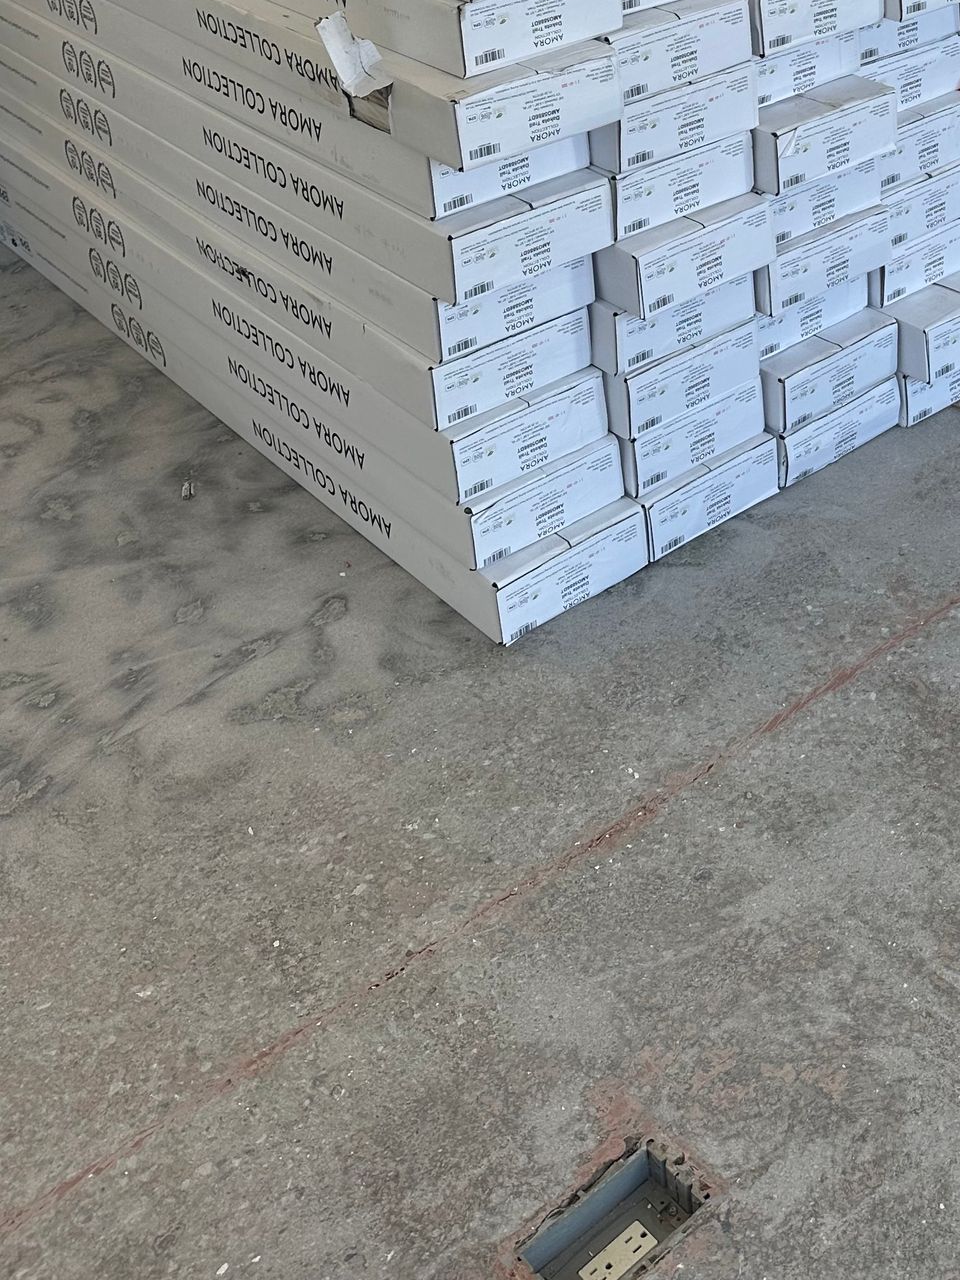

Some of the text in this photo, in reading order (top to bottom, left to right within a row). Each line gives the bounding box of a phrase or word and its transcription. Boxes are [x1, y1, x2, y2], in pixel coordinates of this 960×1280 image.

[814, 24, 837, 36] AMORA
[534, 33, 564, 47] AMORA
[196, 8, 339, 94] AMORA COLLECTION
[672, 68, 699, 81] AMORA
[183, 58, 321, 142] AMORA COLLECTION
[530, 128, 560, 142] AMORA
[679, 136, 705, 149] AMORA
[827, 158, 850, 171] AMORA
[203, 126, 343, 220] AMORA COLLECTION
[501, 176, 531, 190] AMORA
[674, 200, 700, 214] AMORA
[196, 179, 332, 275] AMORA COLLECTION
[813, 215, 835, 228] AMORA
[522, 260, 552, 275] AMORA
[698, 273, 724, 287] AMORA
[827, 275, 848, 289] AMORA
[280, 291, 331, 339] AMORA
[505, 316, 535, 331] AMORA
[677, 328, 703, 344] AMORA
[212, 299, 349, 407] AMORA COLLECTION
[505, 382, 534, 397] AMORA
[686, 393, 710, 407] AMORA
[833, 392, 855, 405] AMORA
[228, 356, 364, 470] AMORA COLLECTION
[690, 448, 715, 463] AMORA
[520, 455, 549, 472] AMORA
[253, 420, 391, 539] AMORA COLLECTION
[707, 510, 731, 527] AMORA
[538, 520, 566, 539] AMORA
[563, 592, 591, 611] AMORA
